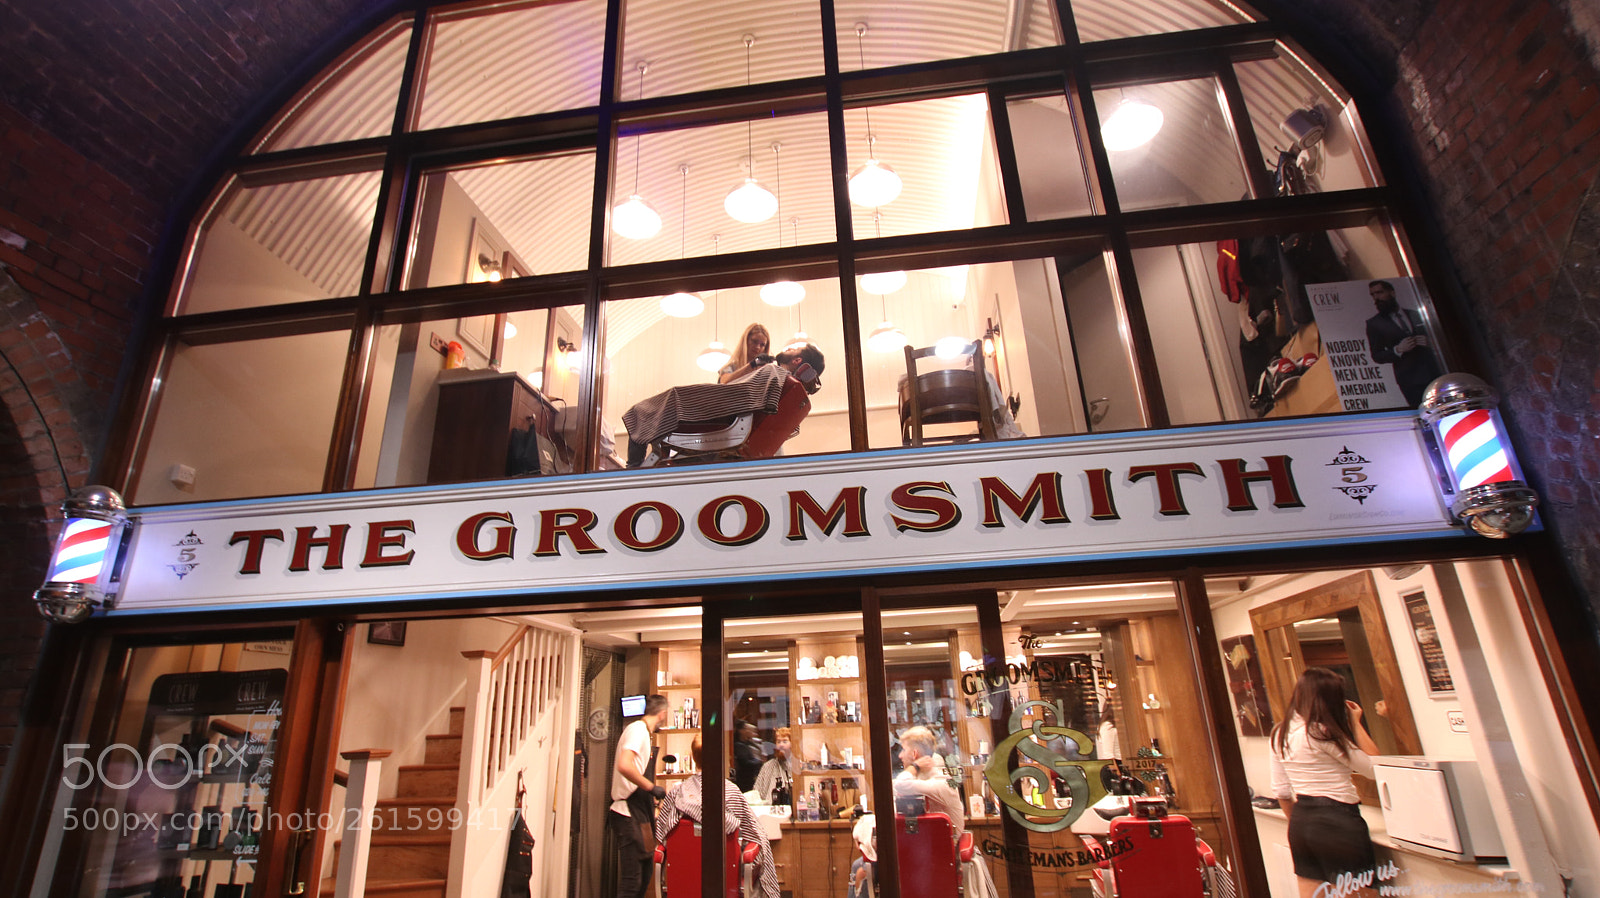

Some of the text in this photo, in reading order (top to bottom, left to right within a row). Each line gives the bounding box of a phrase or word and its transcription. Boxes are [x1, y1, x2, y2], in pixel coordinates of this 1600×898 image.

[1312, 292, 1341, 306] CREW
[1325, 339, 1366, 354] NOBODY
[1329, 353, 1368, 368] KNOWS
[1334, 366, 1383, 382] MEN LIKE
[1339, 382, 1387, 397] AMERICAN
[1343, 398, 1369, 411] CREW
[1341, 466, 1367, 483] 5
[228, 455, 1306, 575] THE GROOMSMITH
[177, 547, 197, 562] 5
[1018, 634, 1043, 650] The
[168, 681, 268, 704] CREW CREW
[1135, 760, 1156, 769] 2017
[249, 773, 271, 785] Call
[1077, 836, 1134, 866] BARBERS
[1311, 869, 1374, 898] Follow
